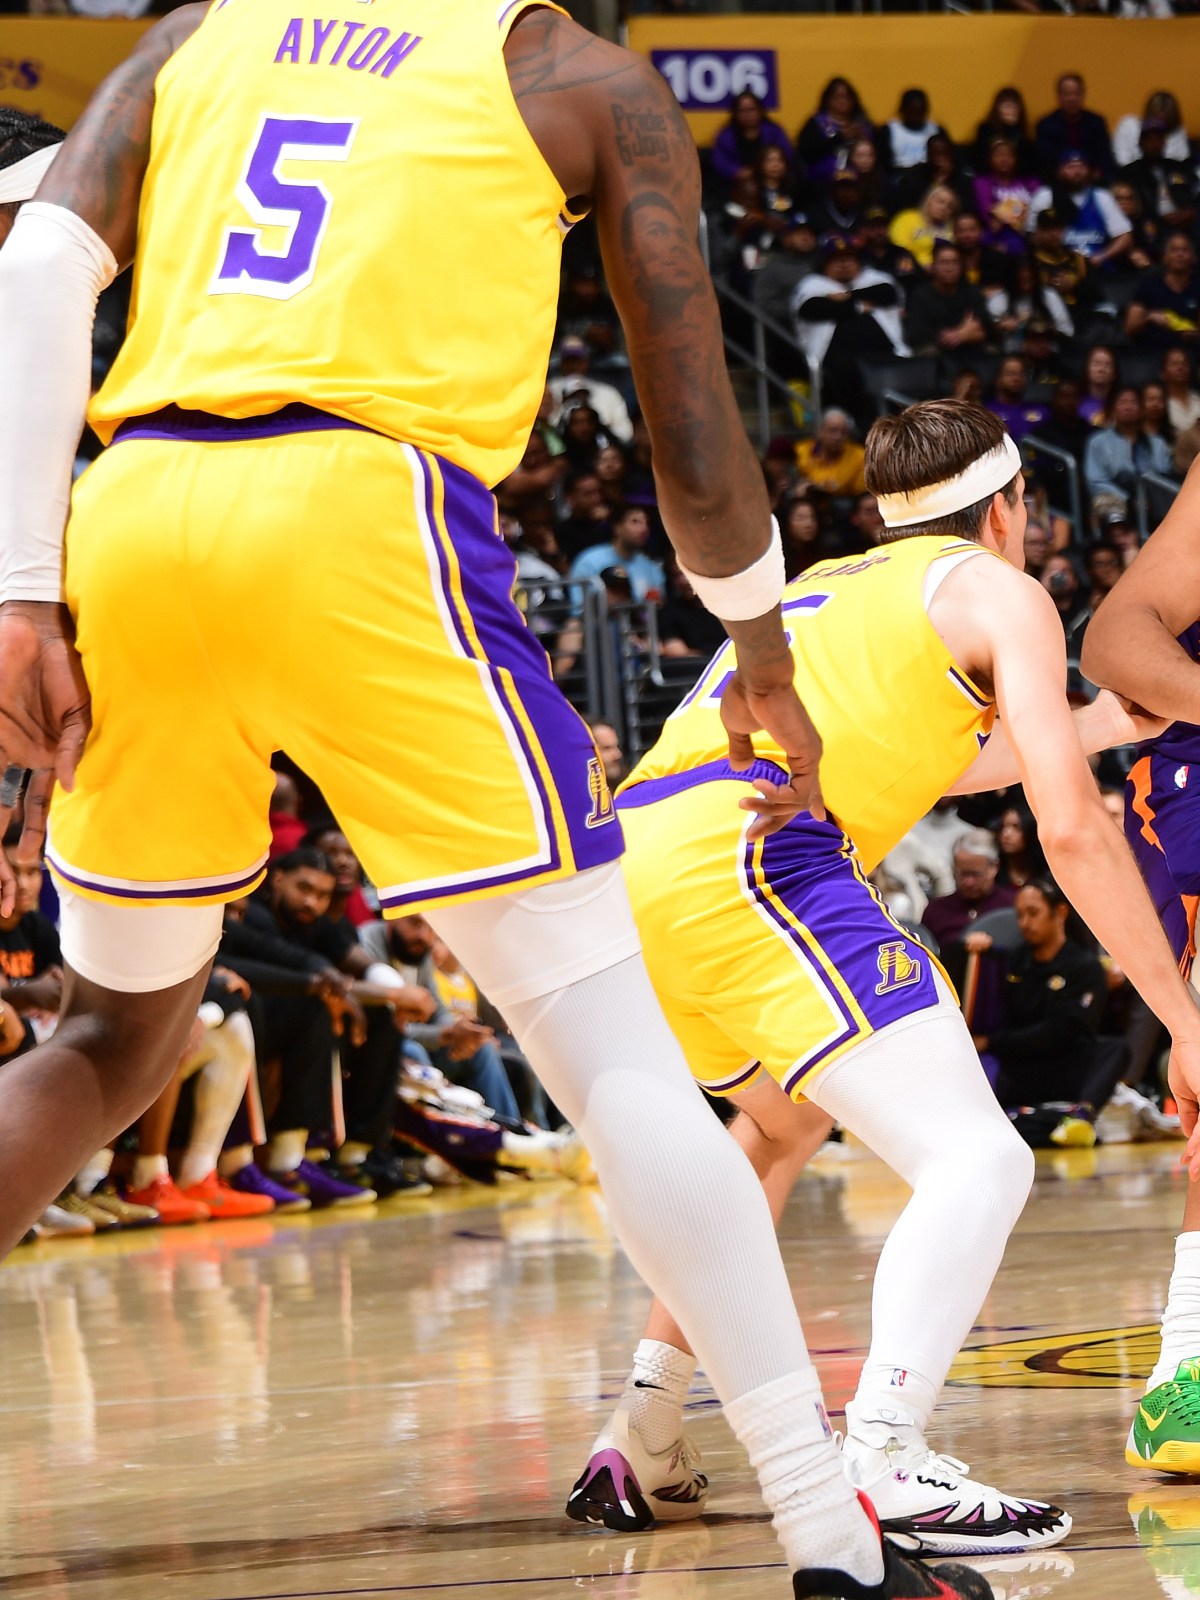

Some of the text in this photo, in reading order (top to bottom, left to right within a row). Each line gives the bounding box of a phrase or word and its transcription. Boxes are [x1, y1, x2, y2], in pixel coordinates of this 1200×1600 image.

[273, 17, 424, 80] AYTON
[660, 54, 769, 104] 106
[208, 111, 362, 301] 5
